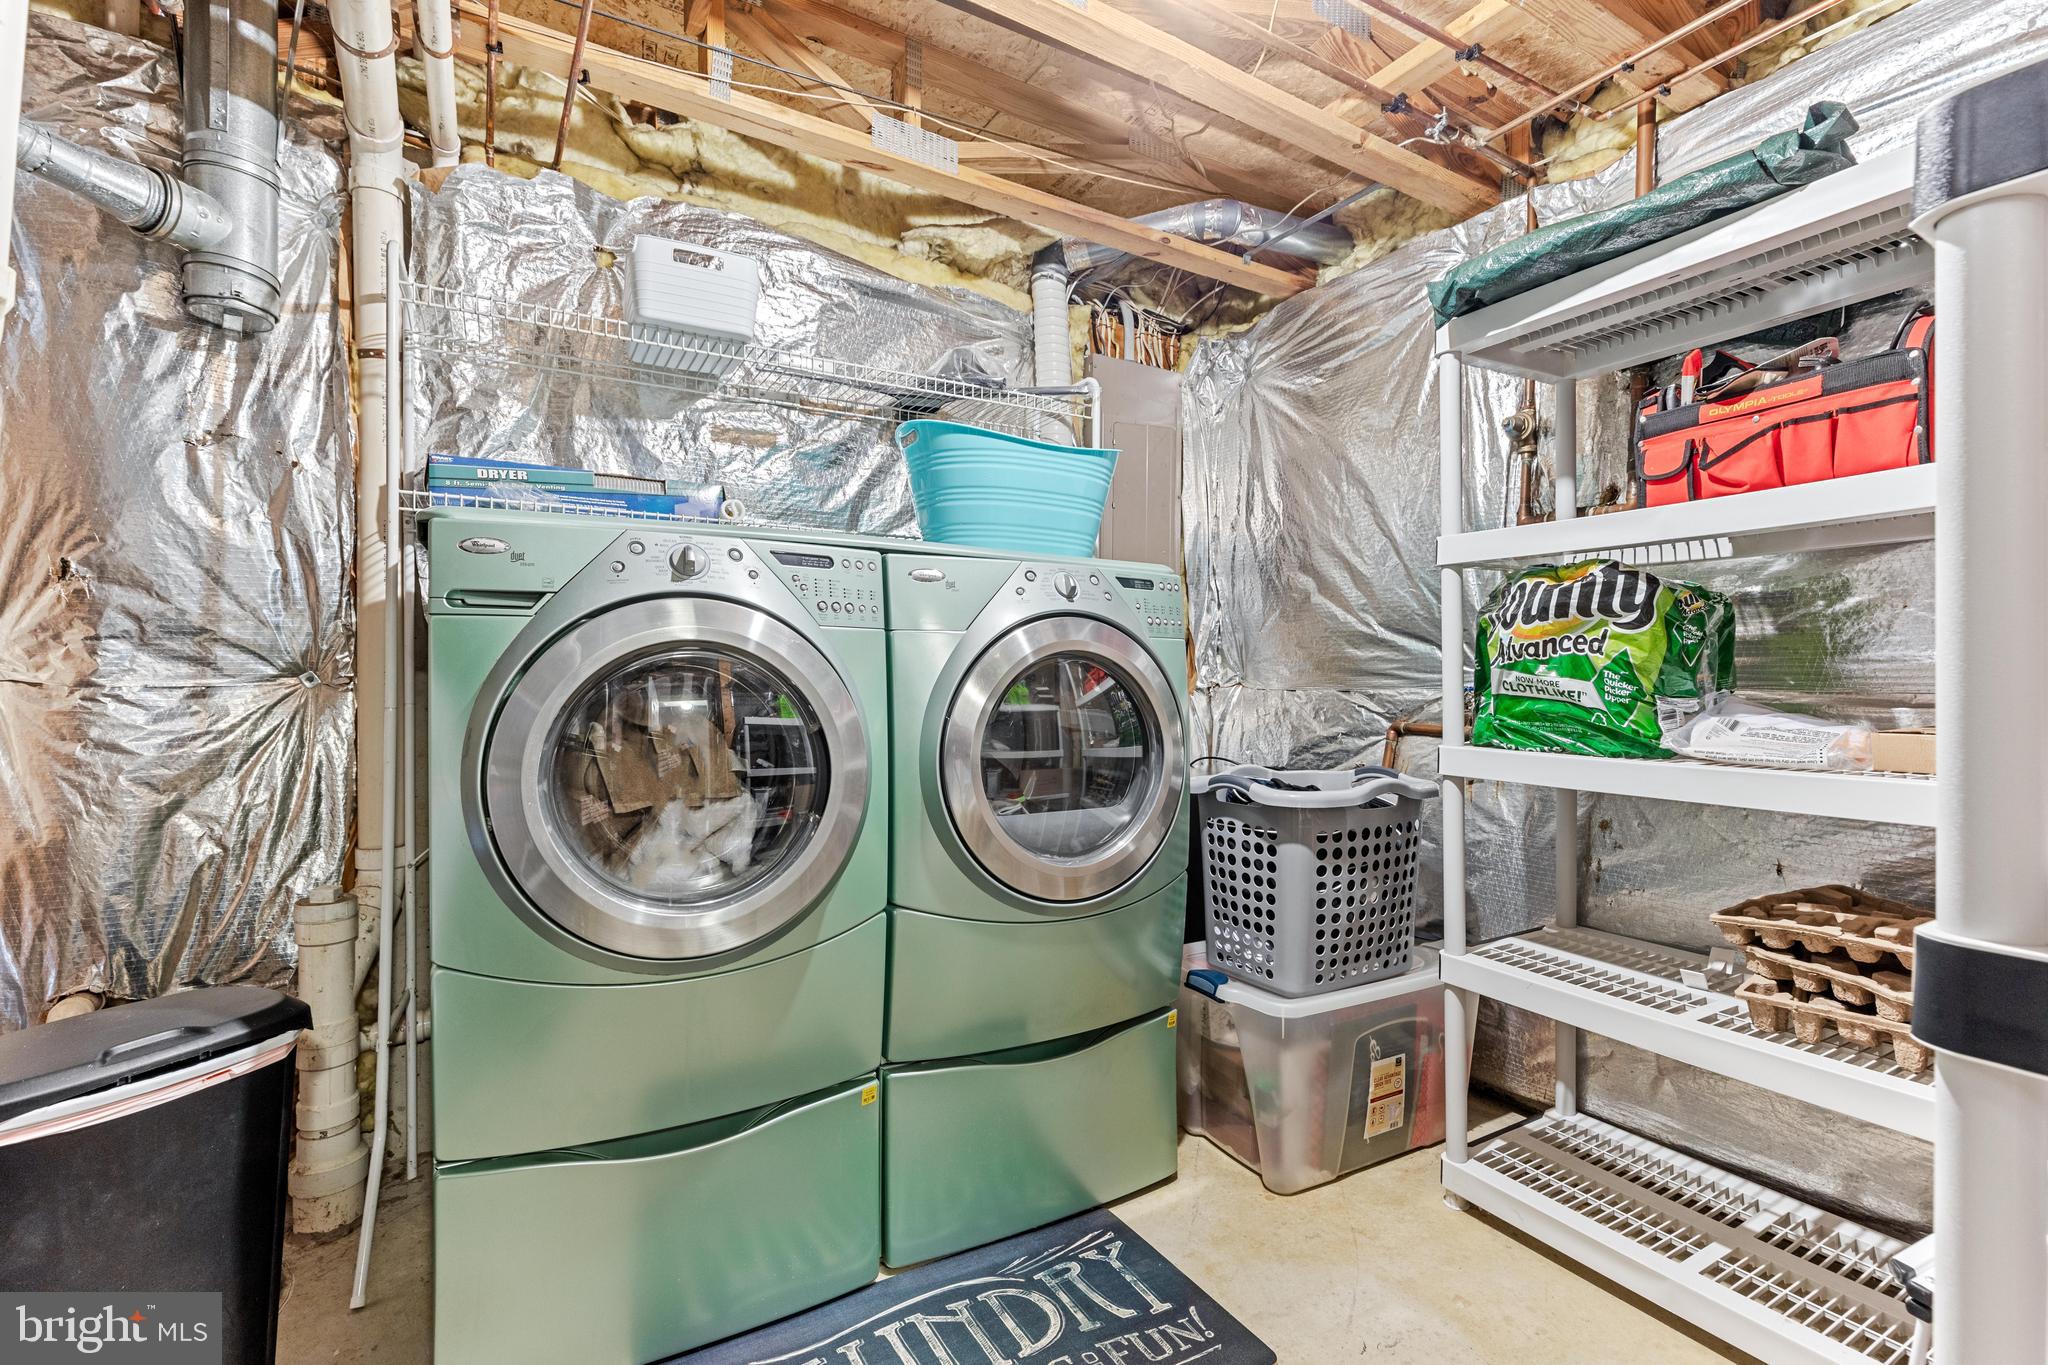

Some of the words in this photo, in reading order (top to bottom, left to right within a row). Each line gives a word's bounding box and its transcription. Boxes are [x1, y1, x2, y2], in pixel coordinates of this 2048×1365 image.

[1709, 397, 1766, 416] OLYMPIA
[476, 468, 528, 480] DRYER
[1603, 670, 1620, 680] The
[1516, 676, 1534, 684] NOW
[1536, 679, 1560, 688] MORE
[1604, 678, 1639, 691] Quicker
[1604, 685, 1632, 696] Picker
[1605, 693, 1632, 704] Upper
[1095, 1305, 1215, 1365] FUN!
